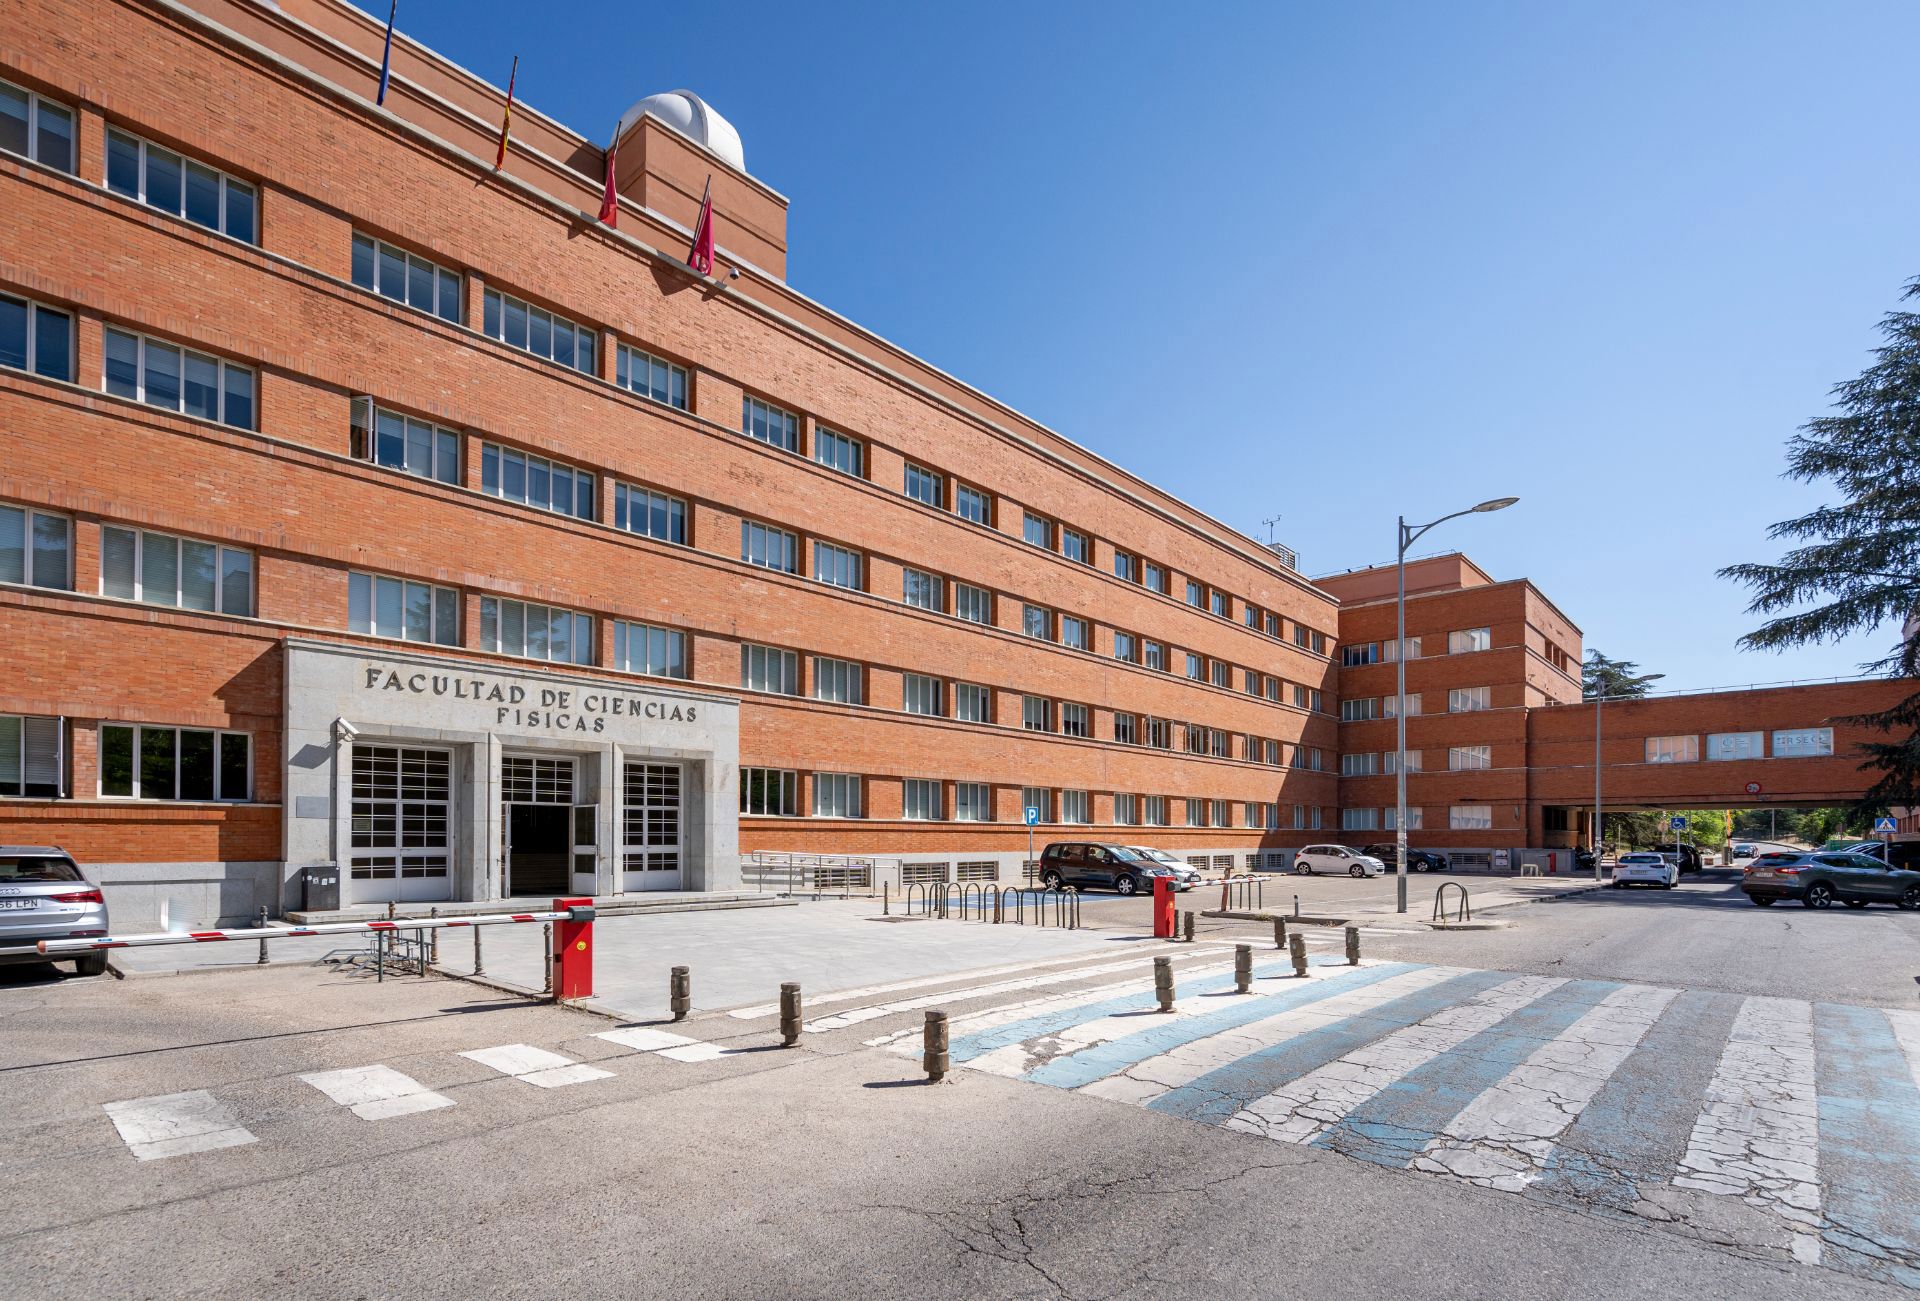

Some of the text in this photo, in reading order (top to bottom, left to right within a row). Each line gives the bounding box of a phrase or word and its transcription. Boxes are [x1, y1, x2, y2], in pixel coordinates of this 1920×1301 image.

[365, 668, 697, 723] FACULTAD DE CIENCIAS
[497, 707, 605, 733] FISICAS
[1028, 808, 1036, 823] P
[16, 899, 38, 907] LPN
